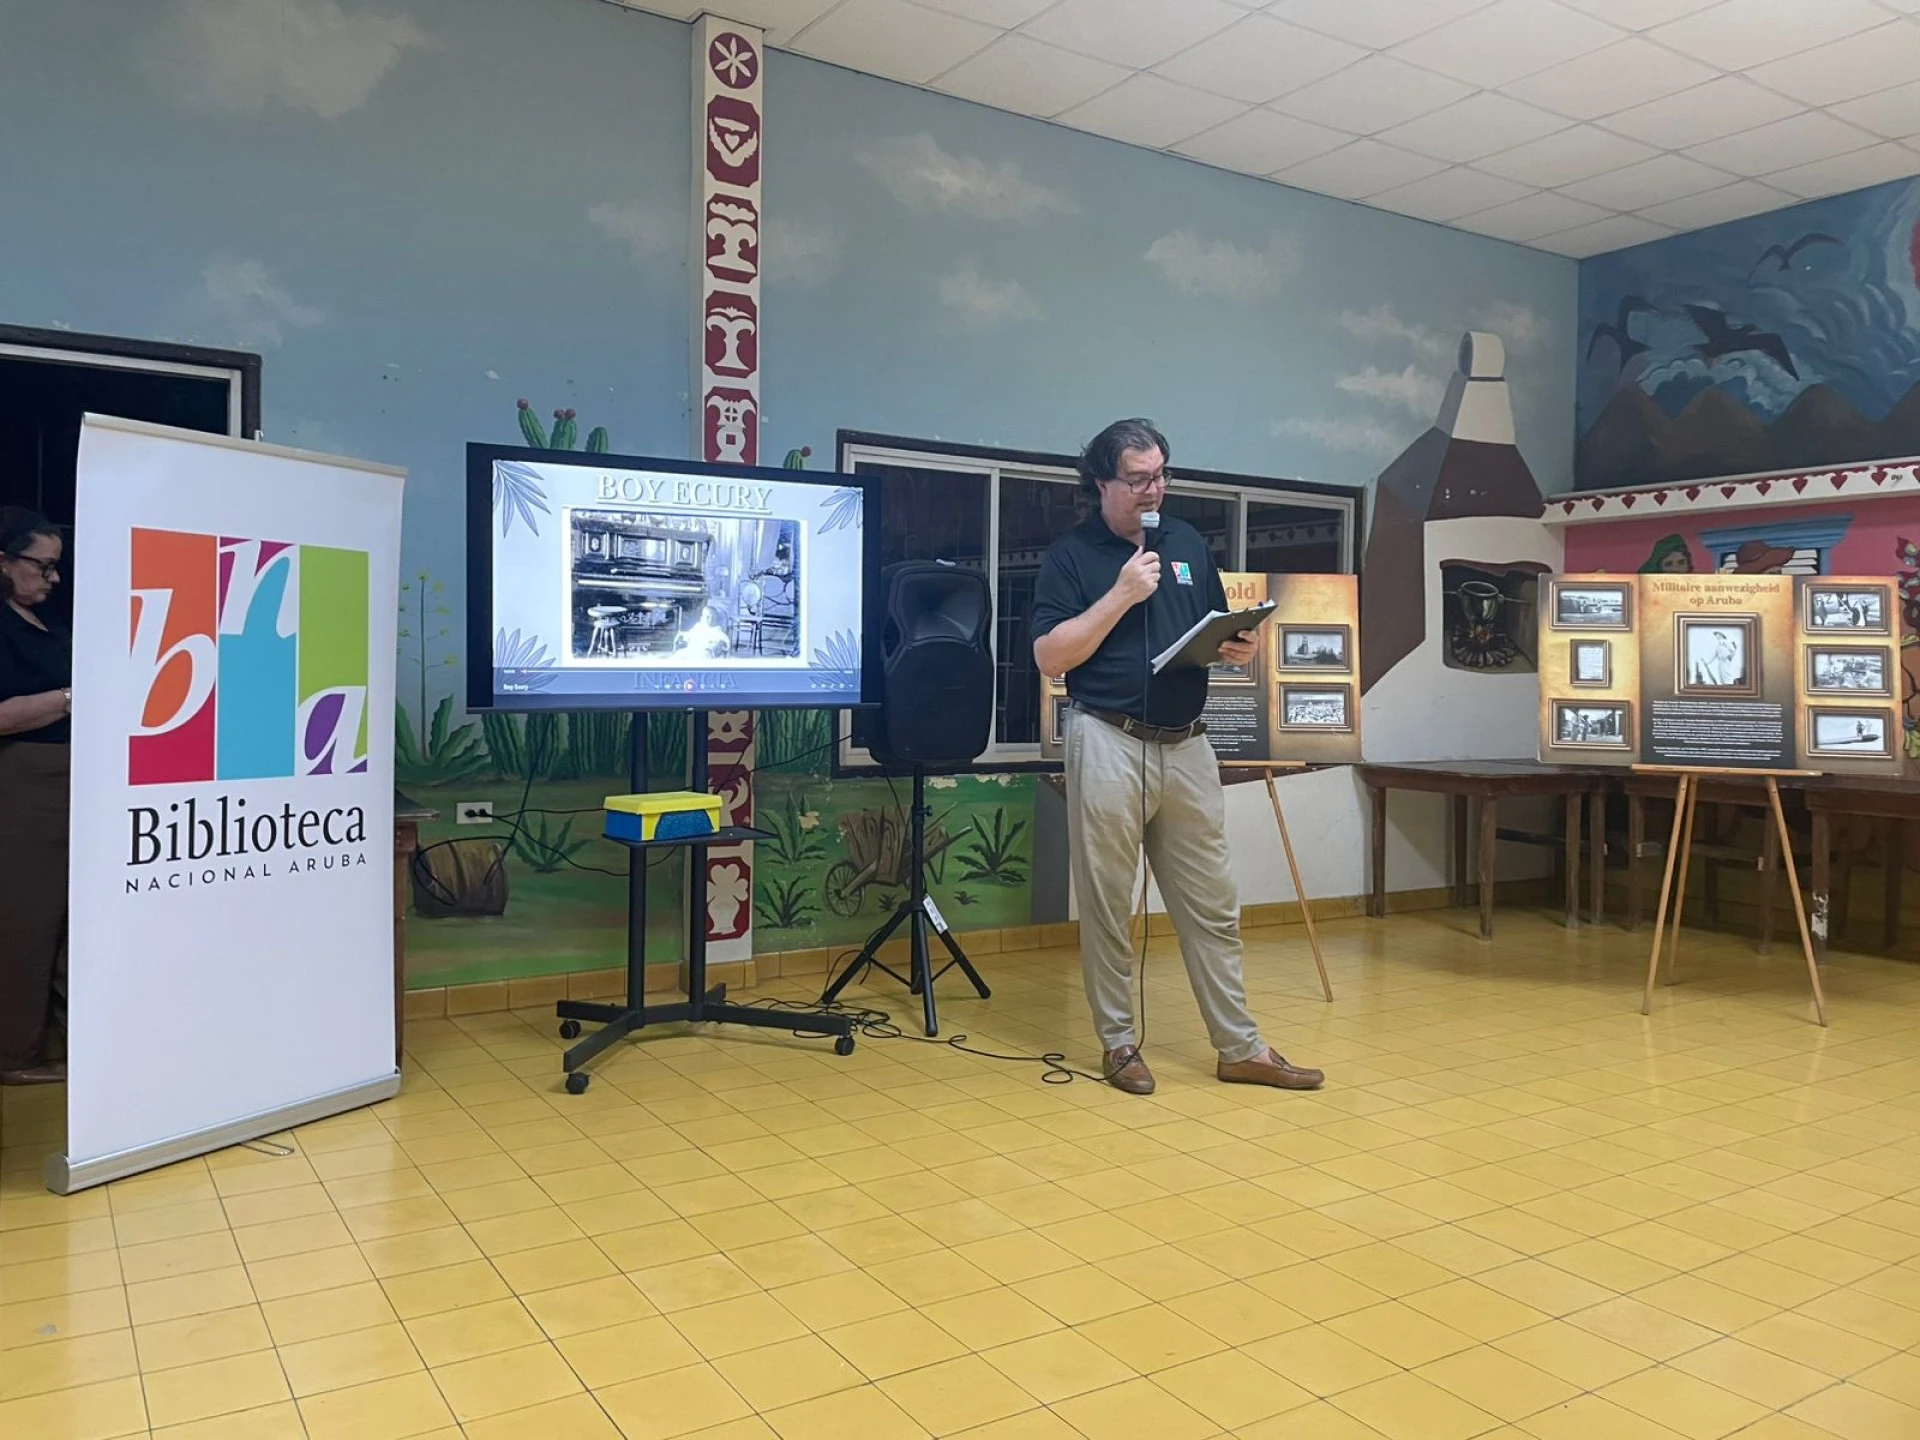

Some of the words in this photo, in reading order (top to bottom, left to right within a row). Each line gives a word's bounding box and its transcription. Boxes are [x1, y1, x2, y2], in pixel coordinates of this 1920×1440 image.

[597, 472, 664, 504] BOY
[672, 480, 773, 511] ECURY
[1225, 582, 1256, 600] old
[1652, 581, 1702, 594] Militaire
[1704, 581, 1780, 595] aanwezigheid
[1689, 597, 1704, 607] op
[1706, 595, 1743, 605] Aruba
[127, 795, 367, 866] Biblioteca
[126, 863, 272, 894] NACIONAL
[288, 852, 367, 874] ARUBA
